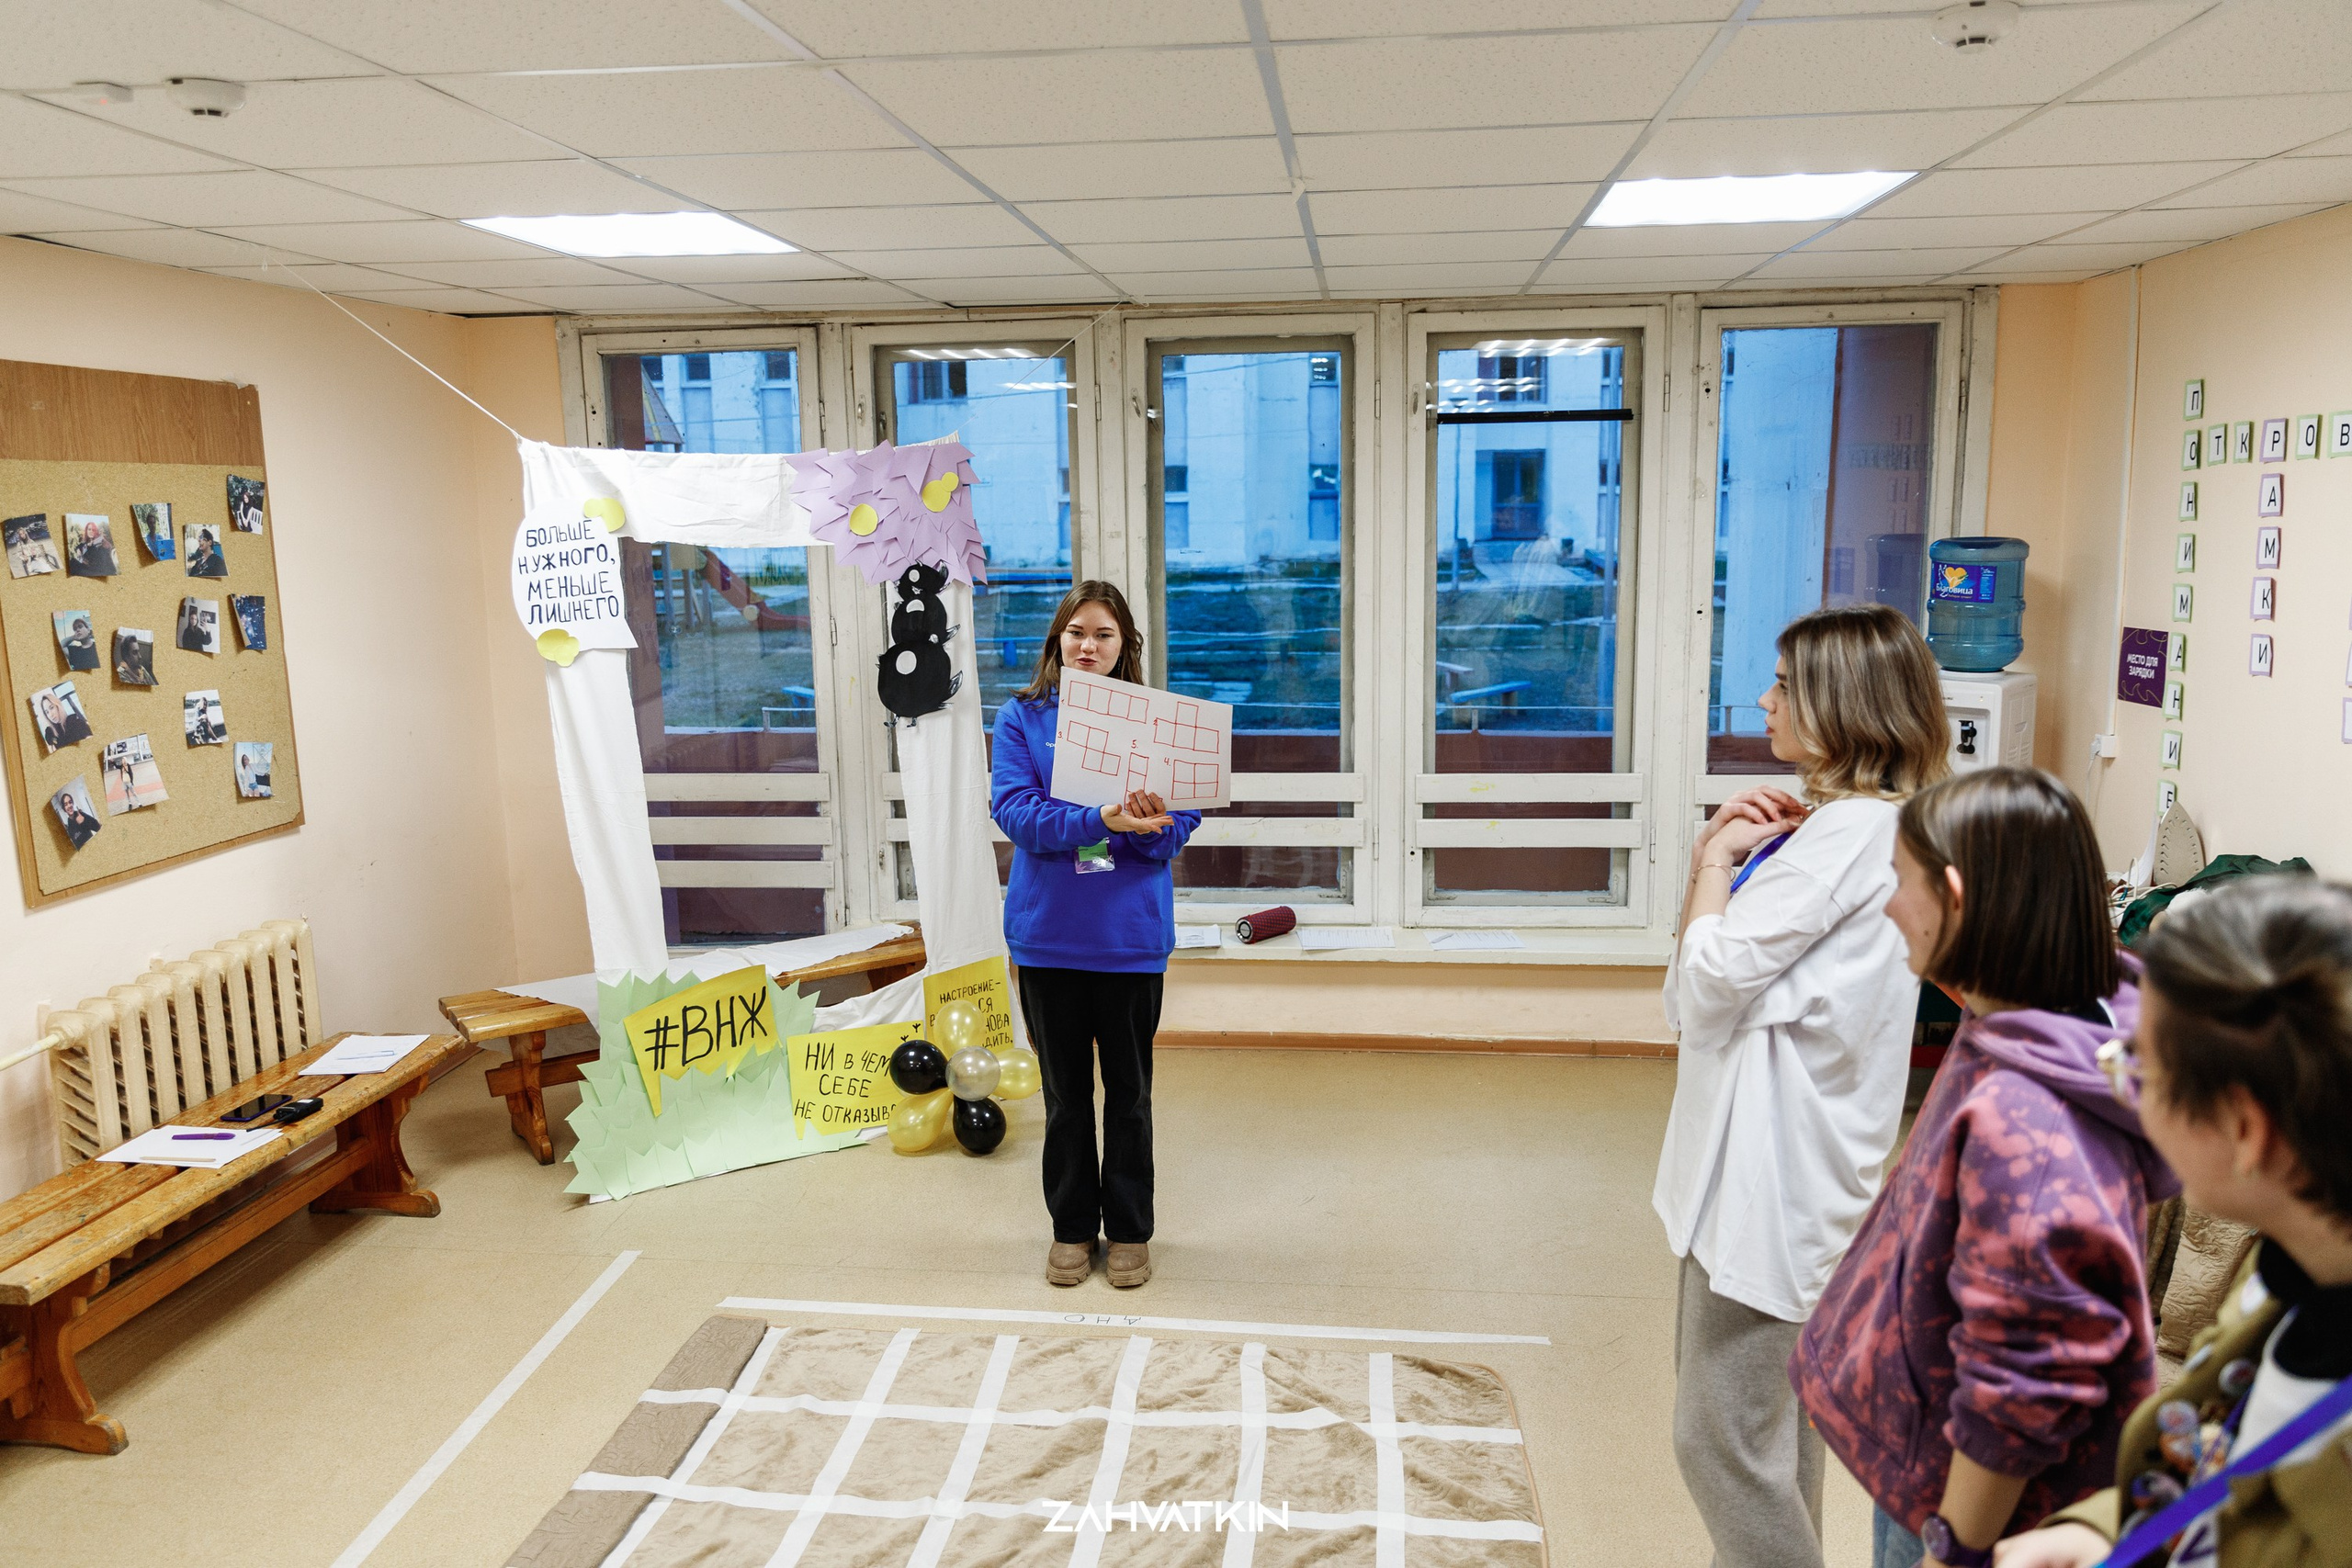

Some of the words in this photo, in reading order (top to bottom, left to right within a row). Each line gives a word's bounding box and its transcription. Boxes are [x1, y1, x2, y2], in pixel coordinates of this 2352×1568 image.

[526, 519, 595, 547] БОЛЬШЕ
[517, 543, 616, 575] НУЖНОГО,
[527, 570, 614, 602] МЕНЬШЕ
[527, 594, 619, 626] ЛИШНЕГО
[2126, 653, 2145, 665] МЕСТО
[2145, 655, 2158, 668] ДЛЯ
[2128, 665, 2155, 679] ЗАРЯДКИ
[1130, 739, 1138, 749] 5.
[1163, 757, 1171, 766] 4.
[644, 986, 768, 1072] #ВНЖ
[805, 1042, 835, 1071] НИ
[861, 1050, 890, 1077] ЧЕМ
[819, 1073, 872, 1098] СЕБЕ
[794, 1099, 816, 1120] НЕ
